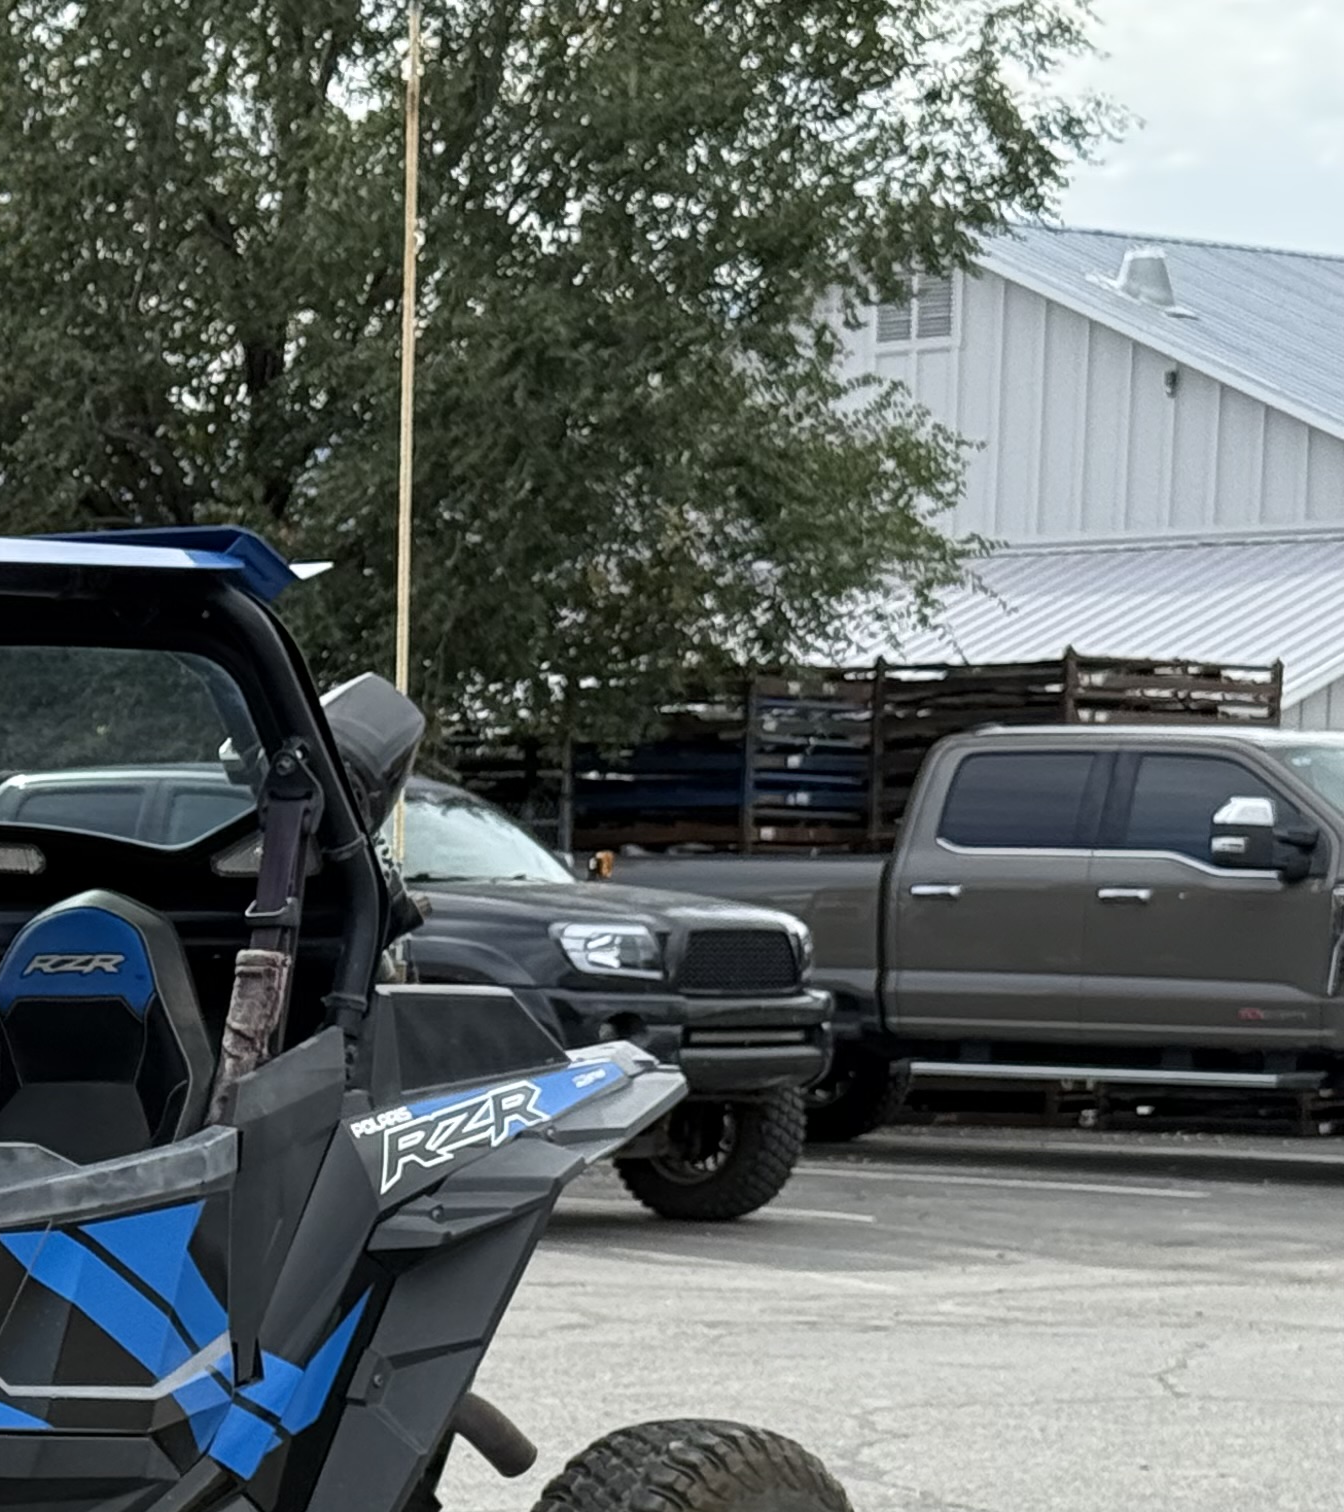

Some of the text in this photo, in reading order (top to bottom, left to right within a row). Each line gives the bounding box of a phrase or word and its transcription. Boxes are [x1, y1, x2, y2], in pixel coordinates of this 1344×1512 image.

[22, 954, 125, 976] RZR
[350, 1106, 412, 1139] POLARIS
[380, 1080, 551, 1195] RZR
